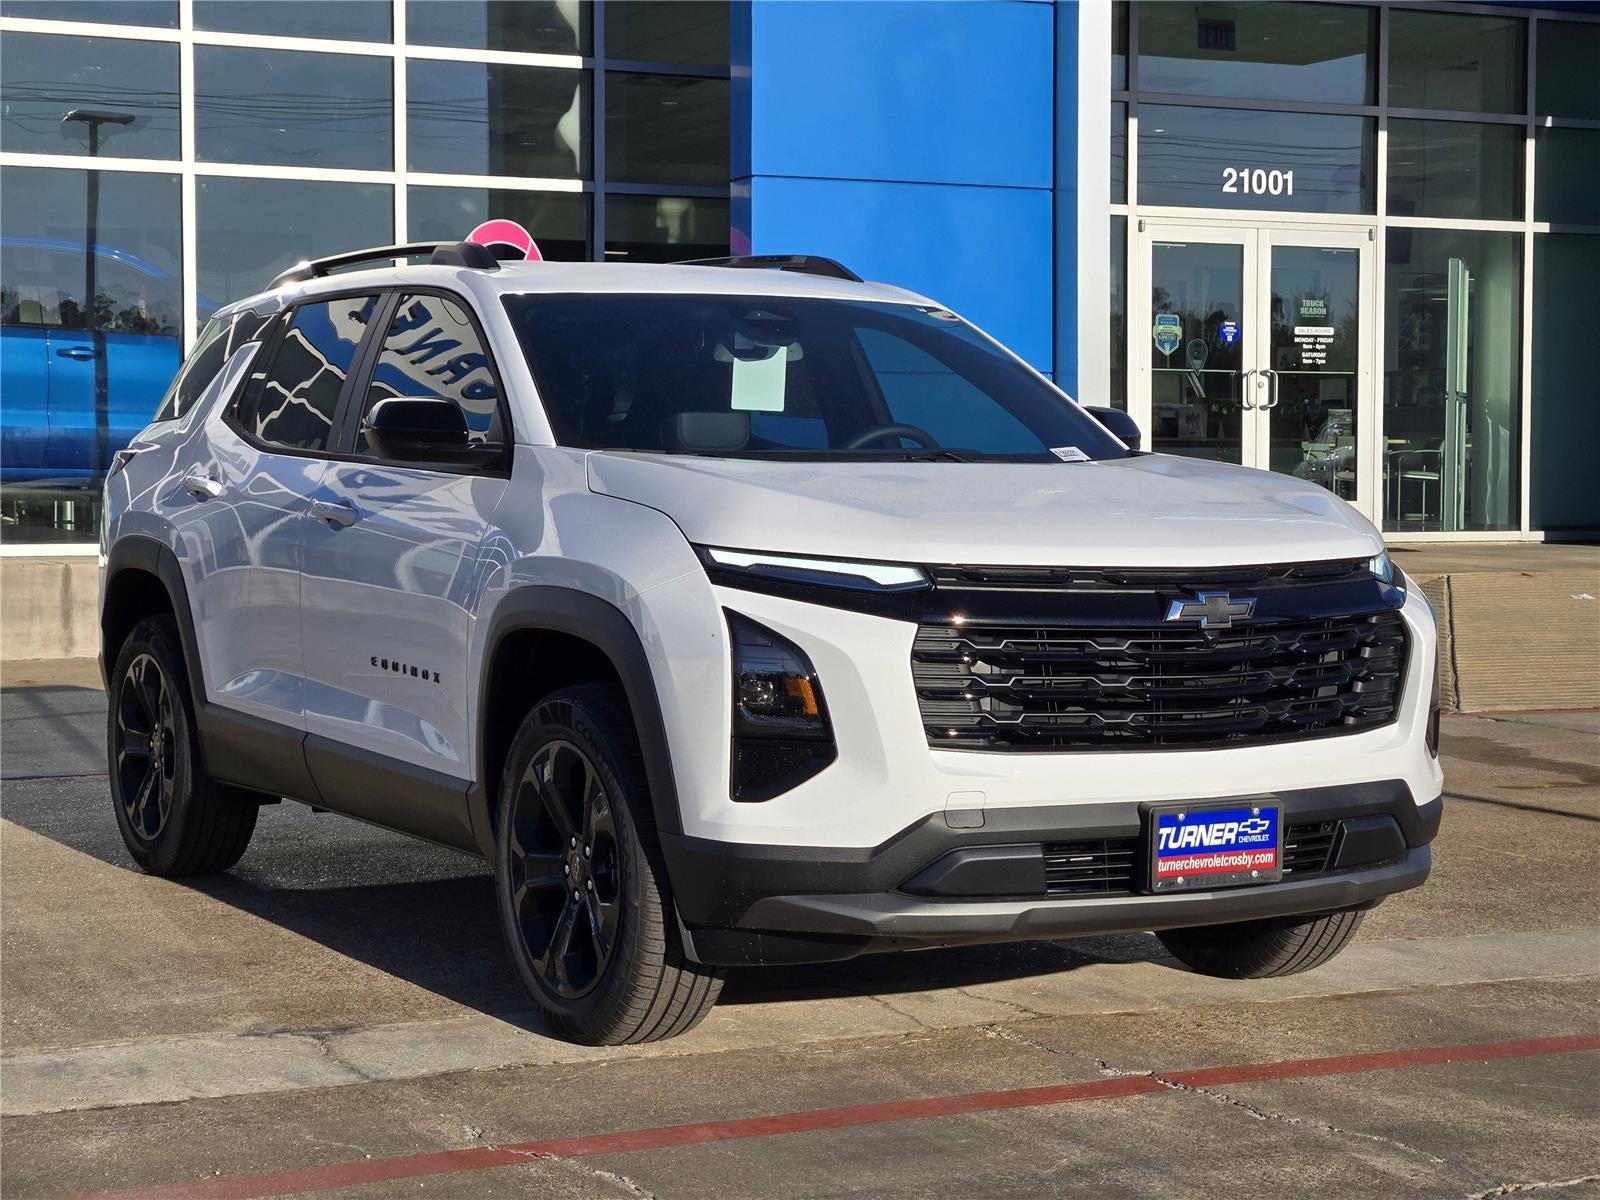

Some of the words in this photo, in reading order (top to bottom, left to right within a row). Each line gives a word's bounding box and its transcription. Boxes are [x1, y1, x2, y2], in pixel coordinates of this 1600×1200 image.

[1222, 167, 1294, 196] 21001
[1301, 307, 1326, 315] SEASON
[370, 656, 440, 684] EQUINOX
[1159, 822, 1238, 850] TURNER
[1239, 834, 1269, 843] CHEVROLET
[1158, 852, 1273, 872] turnerchevroletcrosby.com
